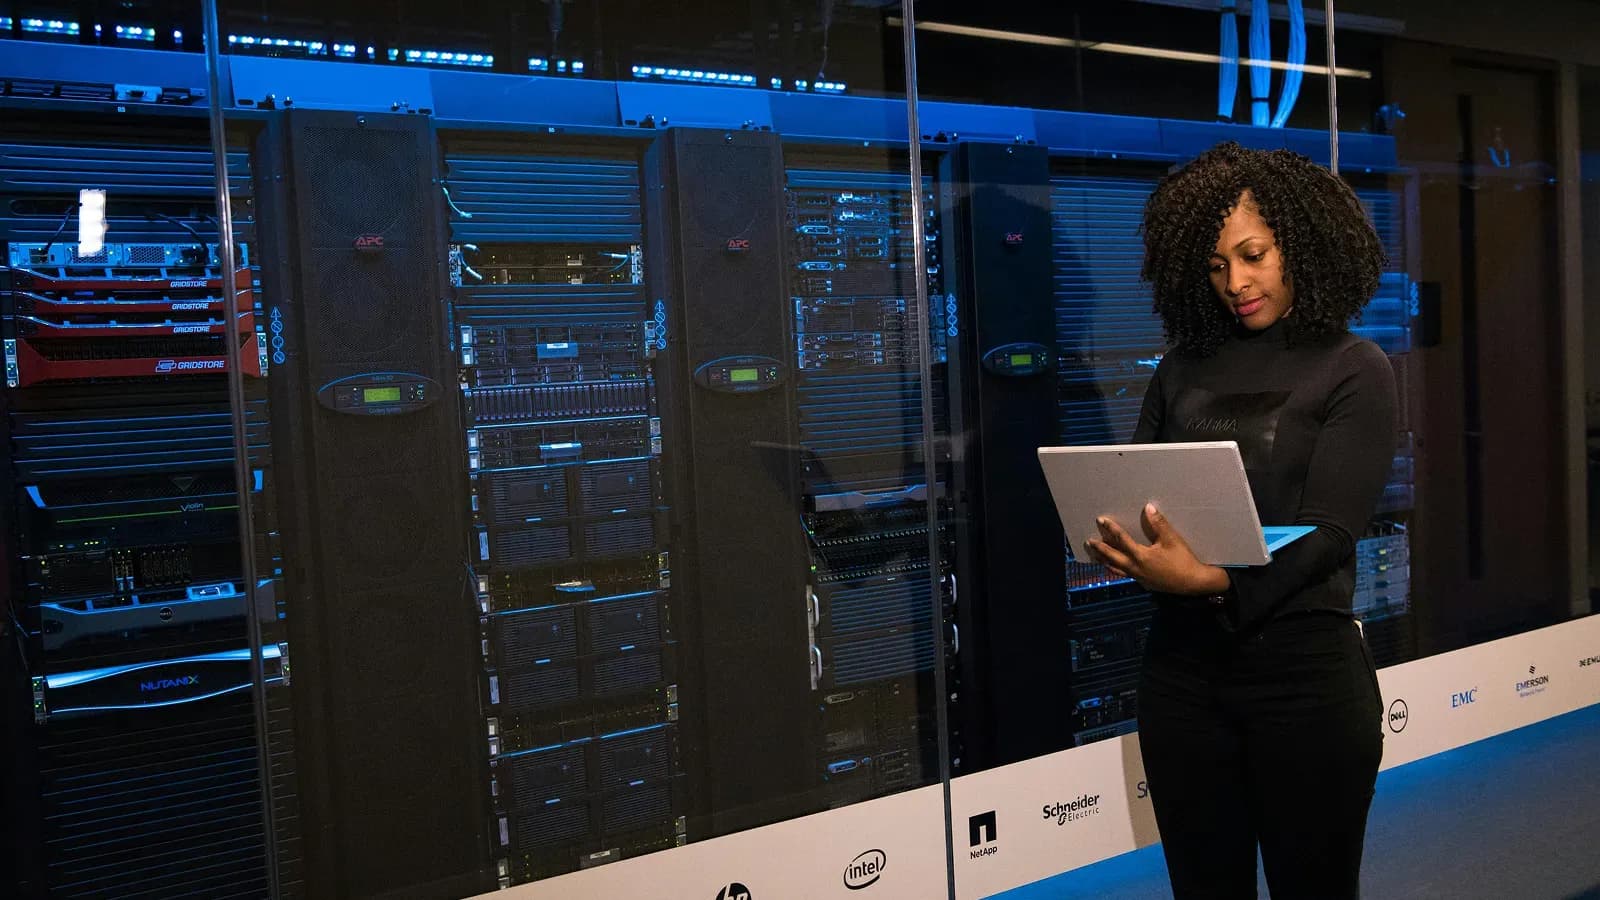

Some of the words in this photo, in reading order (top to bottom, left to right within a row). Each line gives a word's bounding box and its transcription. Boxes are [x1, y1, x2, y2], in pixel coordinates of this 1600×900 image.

[356, 236, 384, 246] APC
[728, 239, 749, 248] APC
[1006, 233, 1023, 241] APC
[177, 360, 225, 369] GRIDSTORE
[140, 674, 200, 692] NUTANIX
[1515, 674, 1549, 692] EMERSON
[1390, 710, 1406, 722] DELL
[1043, 794, 1100, 820] Schneider
[1068, 807, 1100, 822] Electric
[970, 846, 998, 860] NetApp
[849, 856, 880, 880] intel
